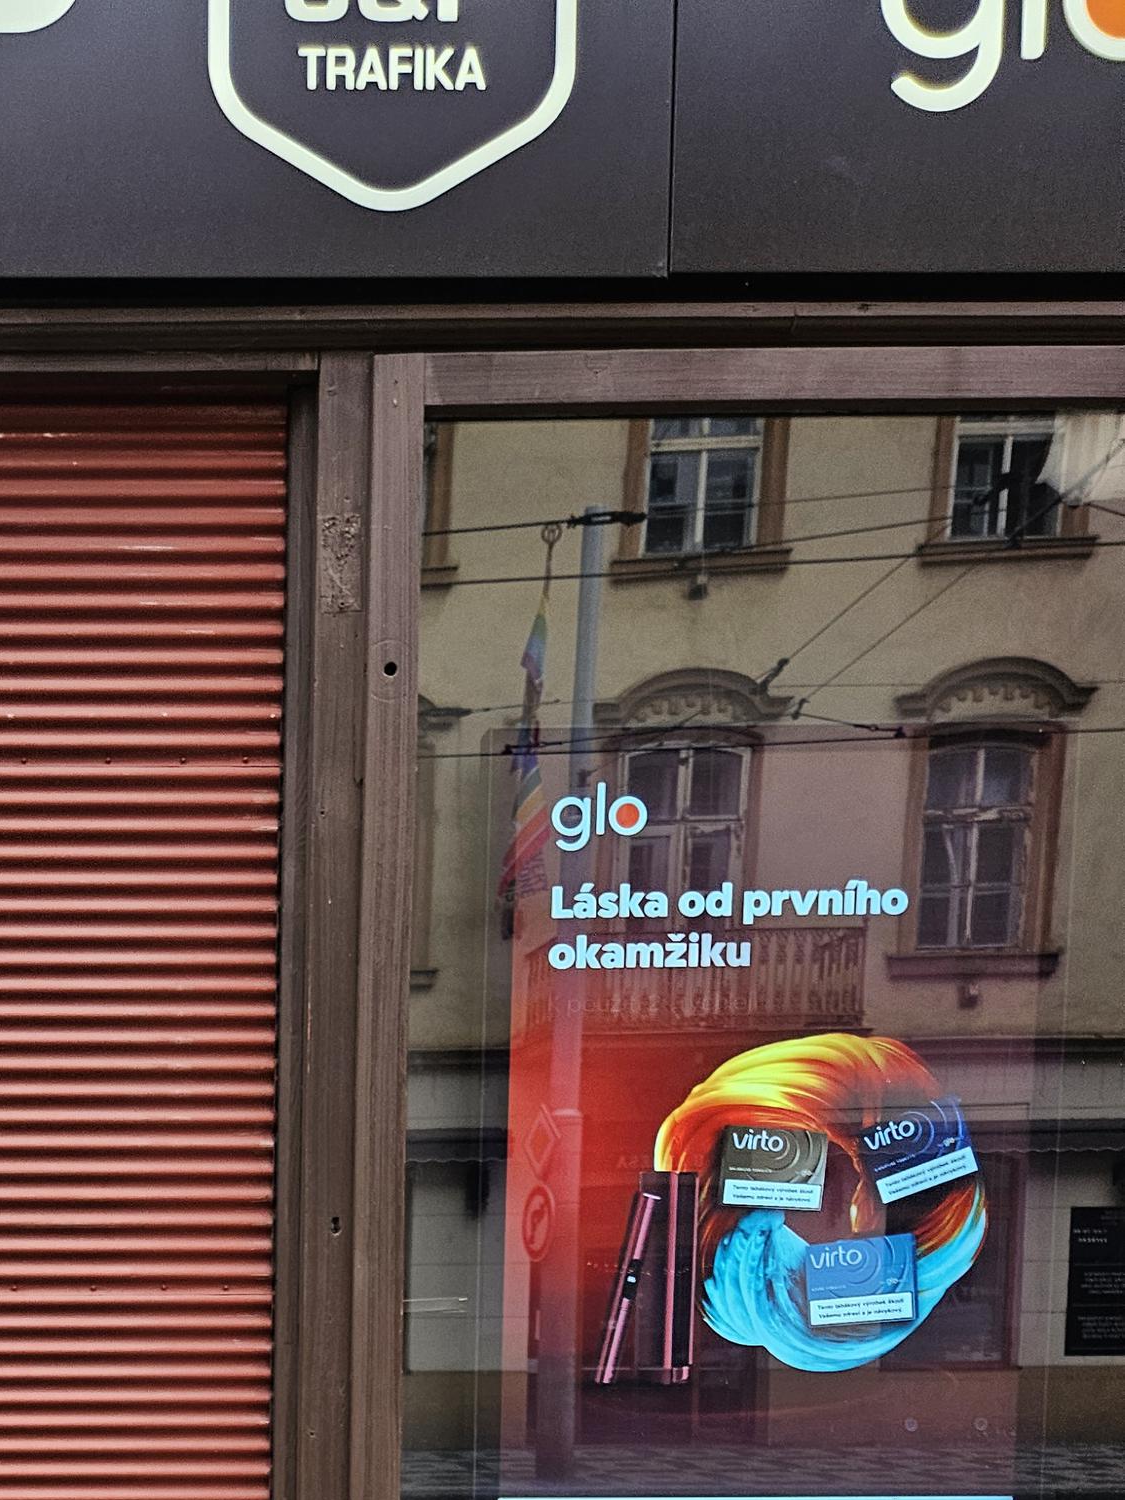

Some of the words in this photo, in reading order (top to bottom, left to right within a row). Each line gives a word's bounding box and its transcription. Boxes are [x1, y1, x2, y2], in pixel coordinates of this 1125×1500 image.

[297, 46, 487, 91] TRAFIKA
[551, 781, 648, 852] glo
[551, 882, 669, 920] Láska
[677, 881, 734, 918] od
[742, 879, 909, 926] prvního
[547, 931, 752, 970] okamžiku
[732, 1128, 784, 1153] virto
[864, 1120, 915, 1151] virto
[810, 1245, 863, 1270] virto
